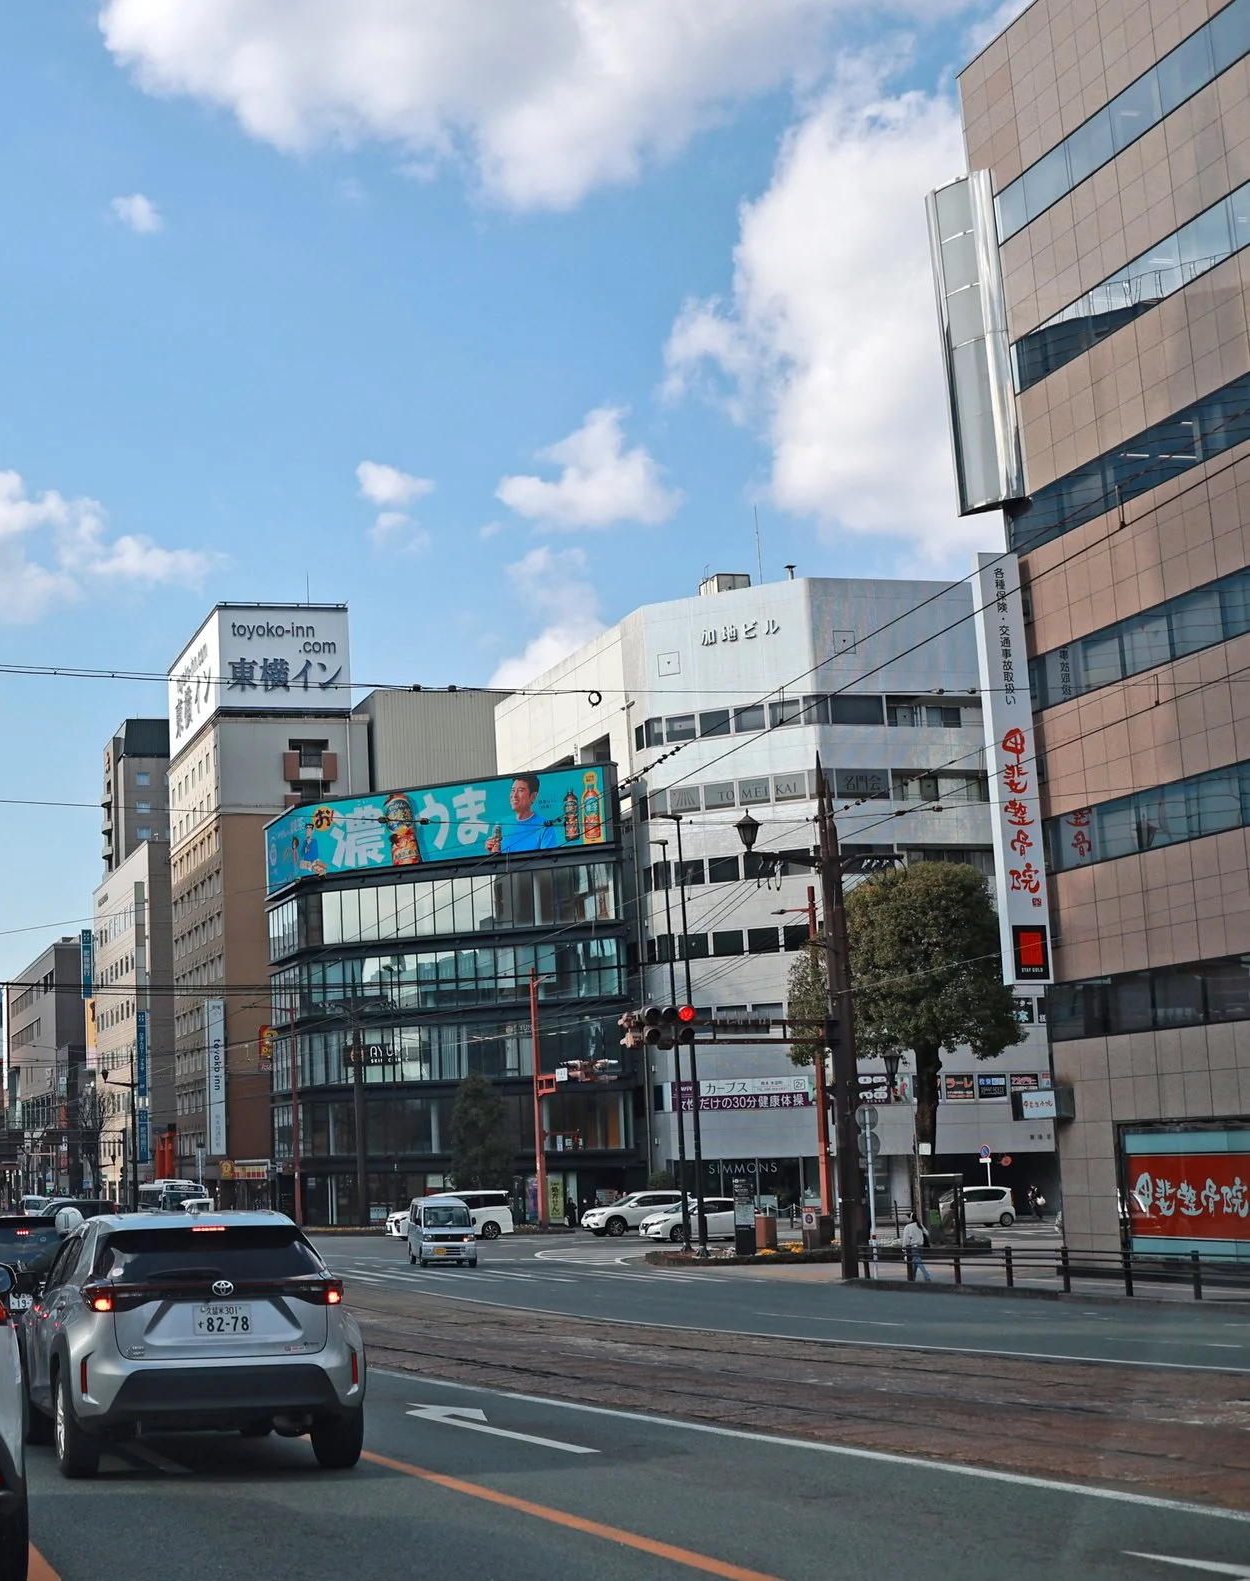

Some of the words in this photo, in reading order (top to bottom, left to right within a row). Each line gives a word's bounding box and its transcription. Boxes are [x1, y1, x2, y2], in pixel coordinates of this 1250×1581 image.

[231, 621, 316, 640] toyoko-inn
[700, 618, 781, 647] 加地ビル
[993, 567, 1017, 706] 各種保険・交通事故取扱い
[298, 640, 337, 654] .com
[227, 657, 343, 693] 東横イン
[843, 774, 882, 792] 名門会
[419, 786, 490, 850] うま
[1001, 727, 1040, 895] 甲斐整骨院
[329, 804, 385, 869] 濃
[705, 1081, 748, 1095] カーブス
[708, 1162, 778, 1175] SIMMONS
[1135, 1172, 1249, 1218] 甲斐整骨院
[206, 1316, 250, 1332] 82-78
